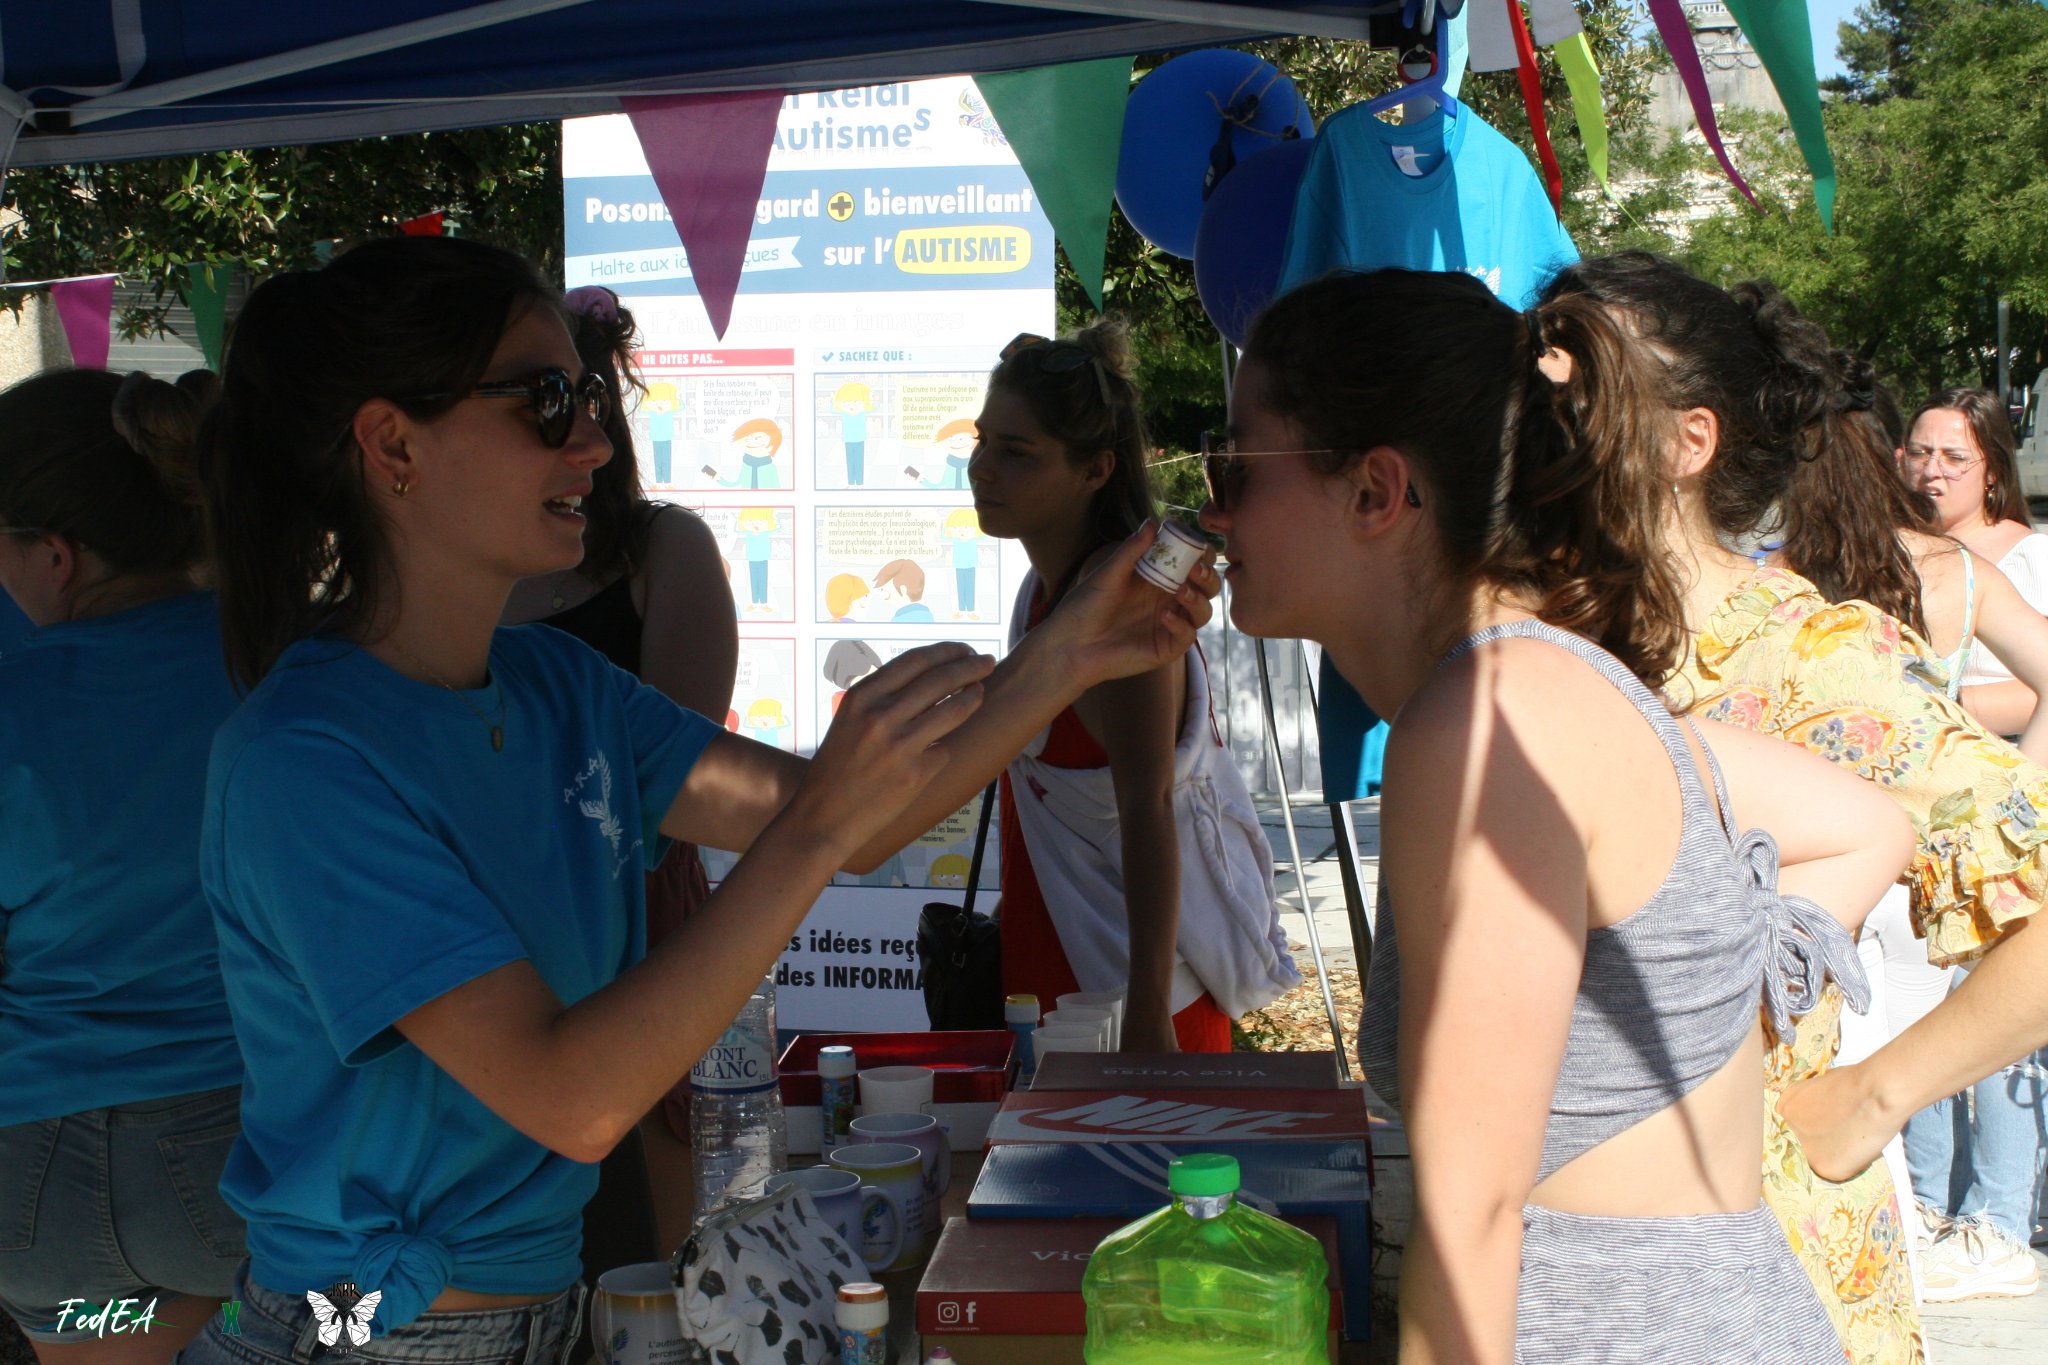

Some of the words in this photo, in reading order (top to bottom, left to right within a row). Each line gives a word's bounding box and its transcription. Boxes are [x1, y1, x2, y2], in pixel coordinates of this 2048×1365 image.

[756, 188, 820, 224] gard
[864, 185, 1034, 216] bienveillant
[591, 257, 636, 277] Halte
[640, 258, 669, 273] aux
[743, 248, 780, 267] çues
[823, 243, 866, 268] sur
[902, 237, 1018, 265] AUTISME
[642, 353, 657, 366] NE
[659, 353, 689, 365] DITES
[838, 350, 880, 363] SACHEZ
[882, 350, 905, 362] QUE
[810, 928, 872, 955] idées
[880, 938, 919, 962] reç
[777, 963, 815, 987] des
[693, 1059, 758, 1079] BLANC
[1034, 1094, 1338, 1136] NIKE
[1031, 1250, 1092, 1261] Vic
